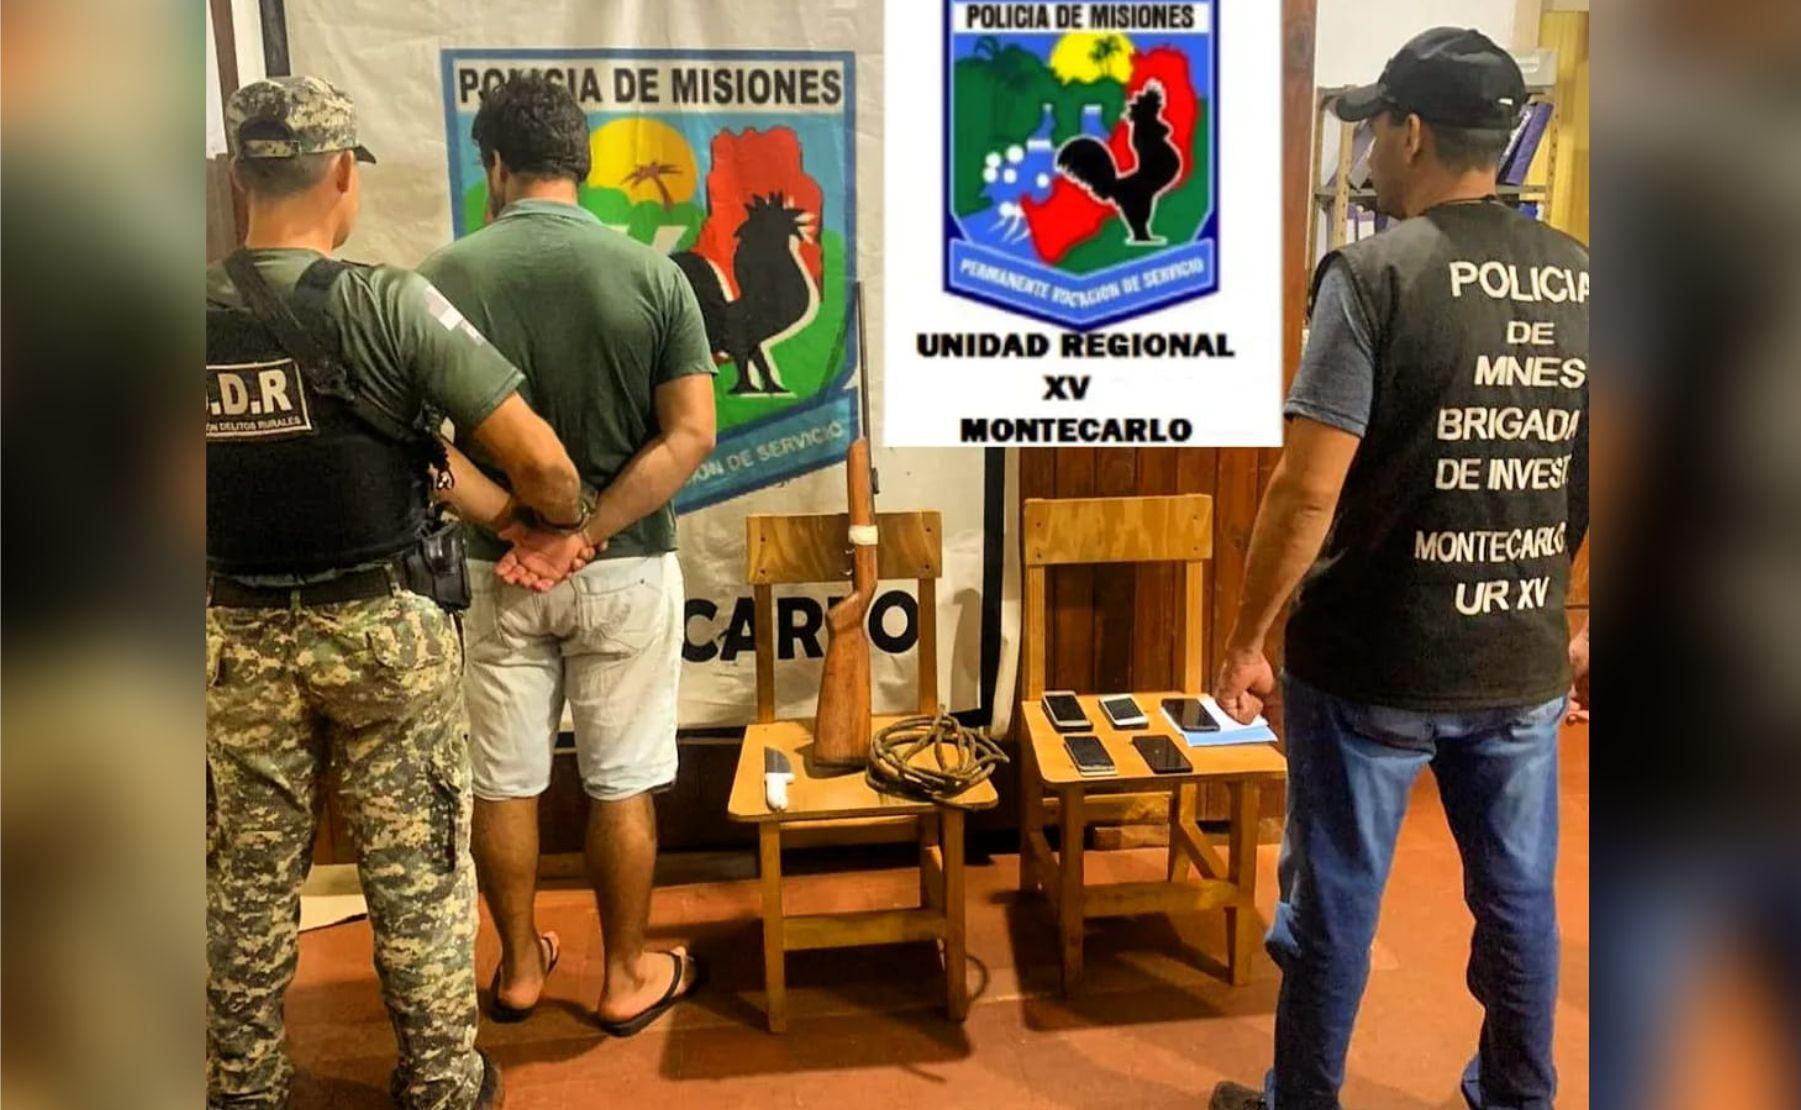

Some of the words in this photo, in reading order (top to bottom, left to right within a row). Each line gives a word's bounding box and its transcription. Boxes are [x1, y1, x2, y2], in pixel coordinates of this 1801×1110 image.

[459, 67, 603, 103] POIA
[614, 68, 660, 104] DE
[671, 68, 842, 105] MISIONES
[1449, 260, 1589, 303] POLICIA
[1506, 320, 1555, 345] DE
[206, 368, 293, 415] .D.R
[1474, 355, 1587, 389] MNES
[1437, 406, 1581, 441] BRIGADA
[726, 450, 754, 471] DE
[755, 420, 844, 462] SERVICIO
[1435, 458, 1482, 490] DE
[1414, 521, 1567, 563] MONTECARLO
[1455, 580, 1510, 616] UR
[1517, 576, 1550, 610] XV
[681, 590, 919, 663] CARO
